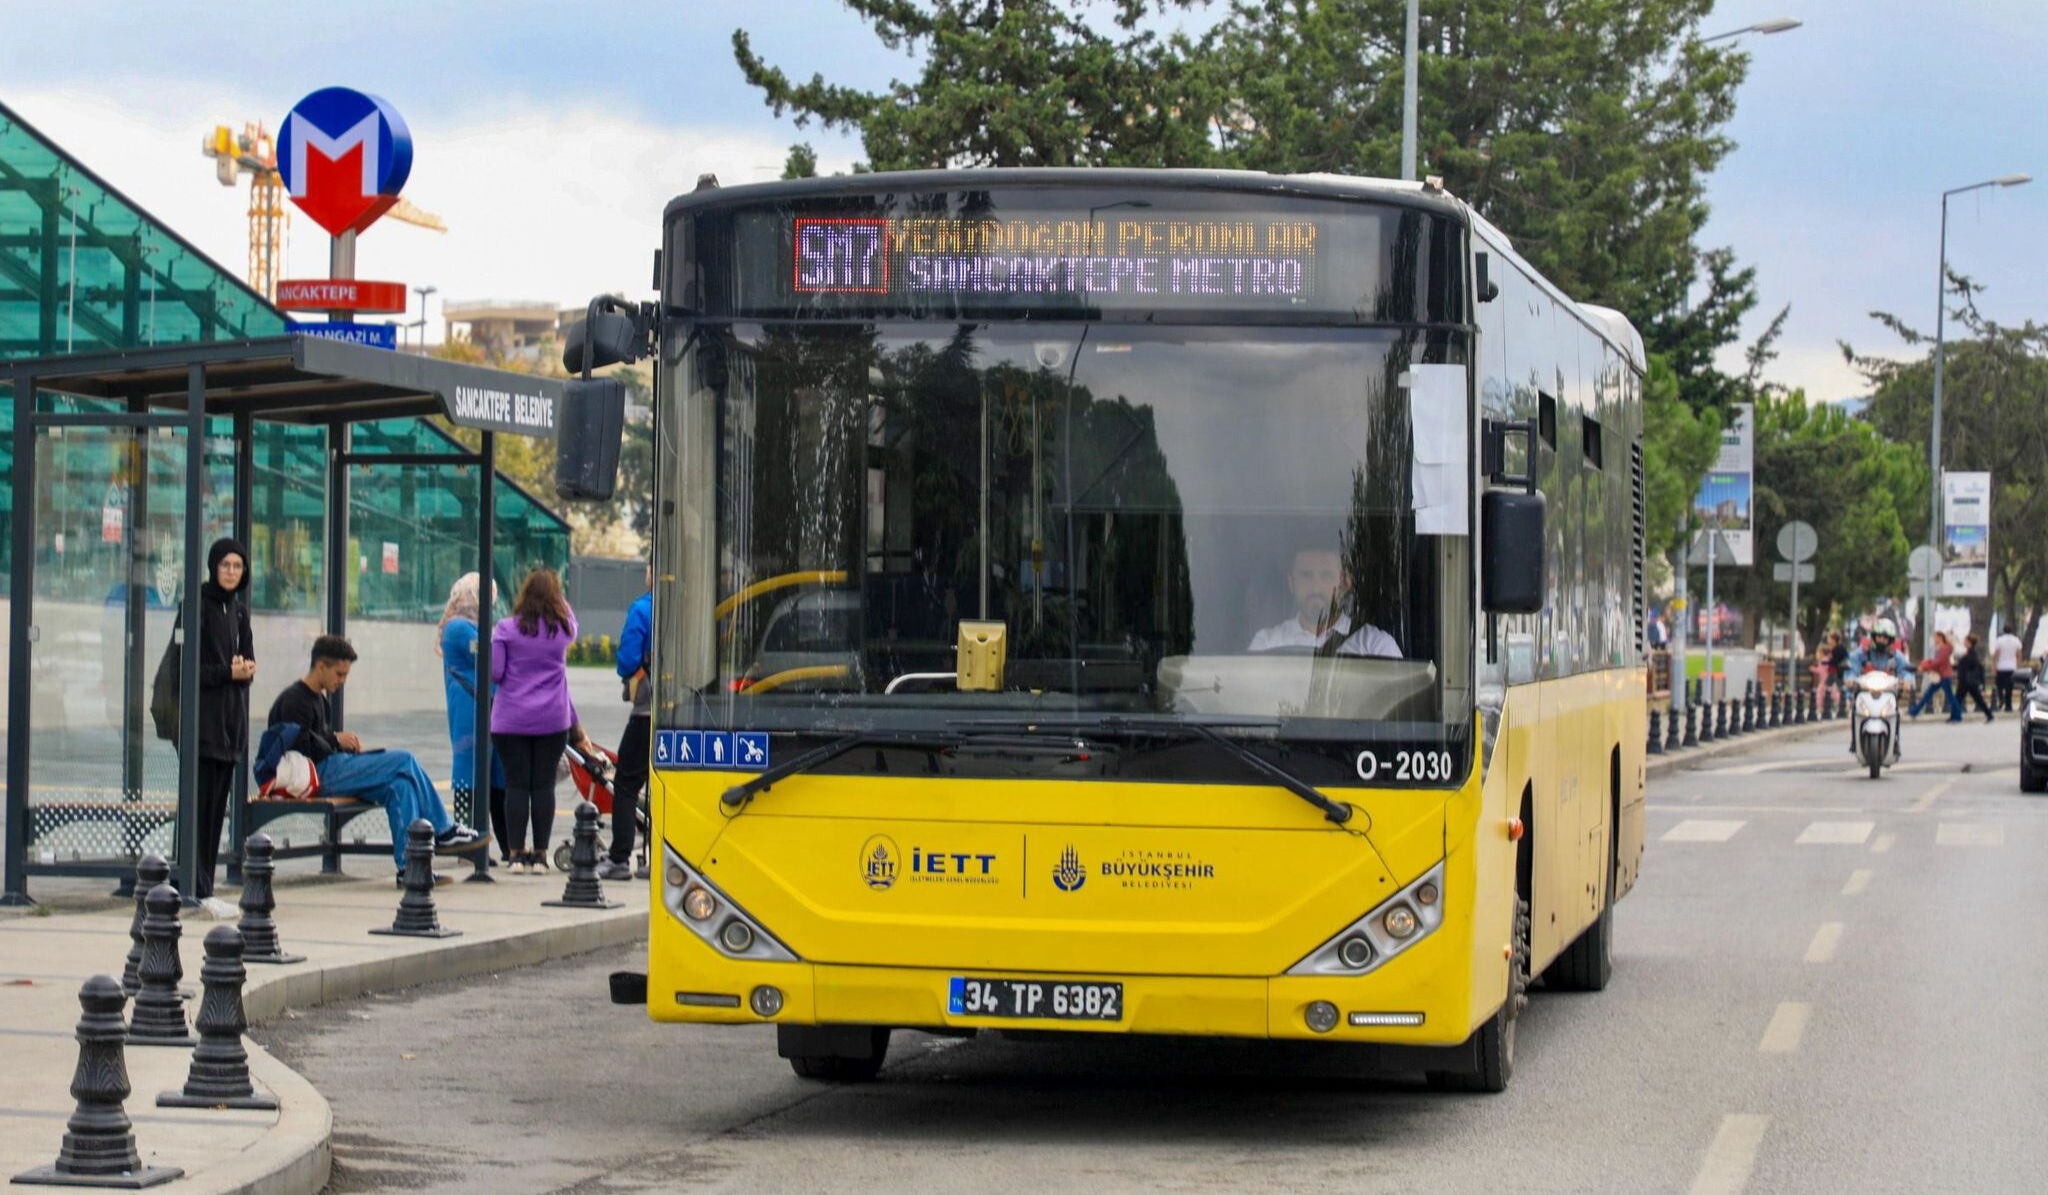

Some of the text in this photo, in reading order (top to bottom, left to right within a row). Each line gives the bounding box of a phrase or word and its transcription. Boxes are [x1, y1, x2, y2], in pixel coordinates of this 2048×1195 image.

[290, 110, 380, 198] M
[1119, 220, 1317, 255] PERONLAR
[802, 226, 878, 285] SM7
[909, 256, 1301, 293] SANCAKTEPE METRO
[455, 385, 553, 428] SANCAKTEPE BELEDİYE
[1356, 750, 1452, 780] O-2030
[913, 847, 997, 874] İETT
[1101, 858, 1215, 880] BÜYÜKŞEHİR
[1121, 849, 1192, 859] İSTANBUL
[1121, 880, 1193, 889] BELEDİYESİ
[965, 981, 1117, 1016] 34 TP 6382
